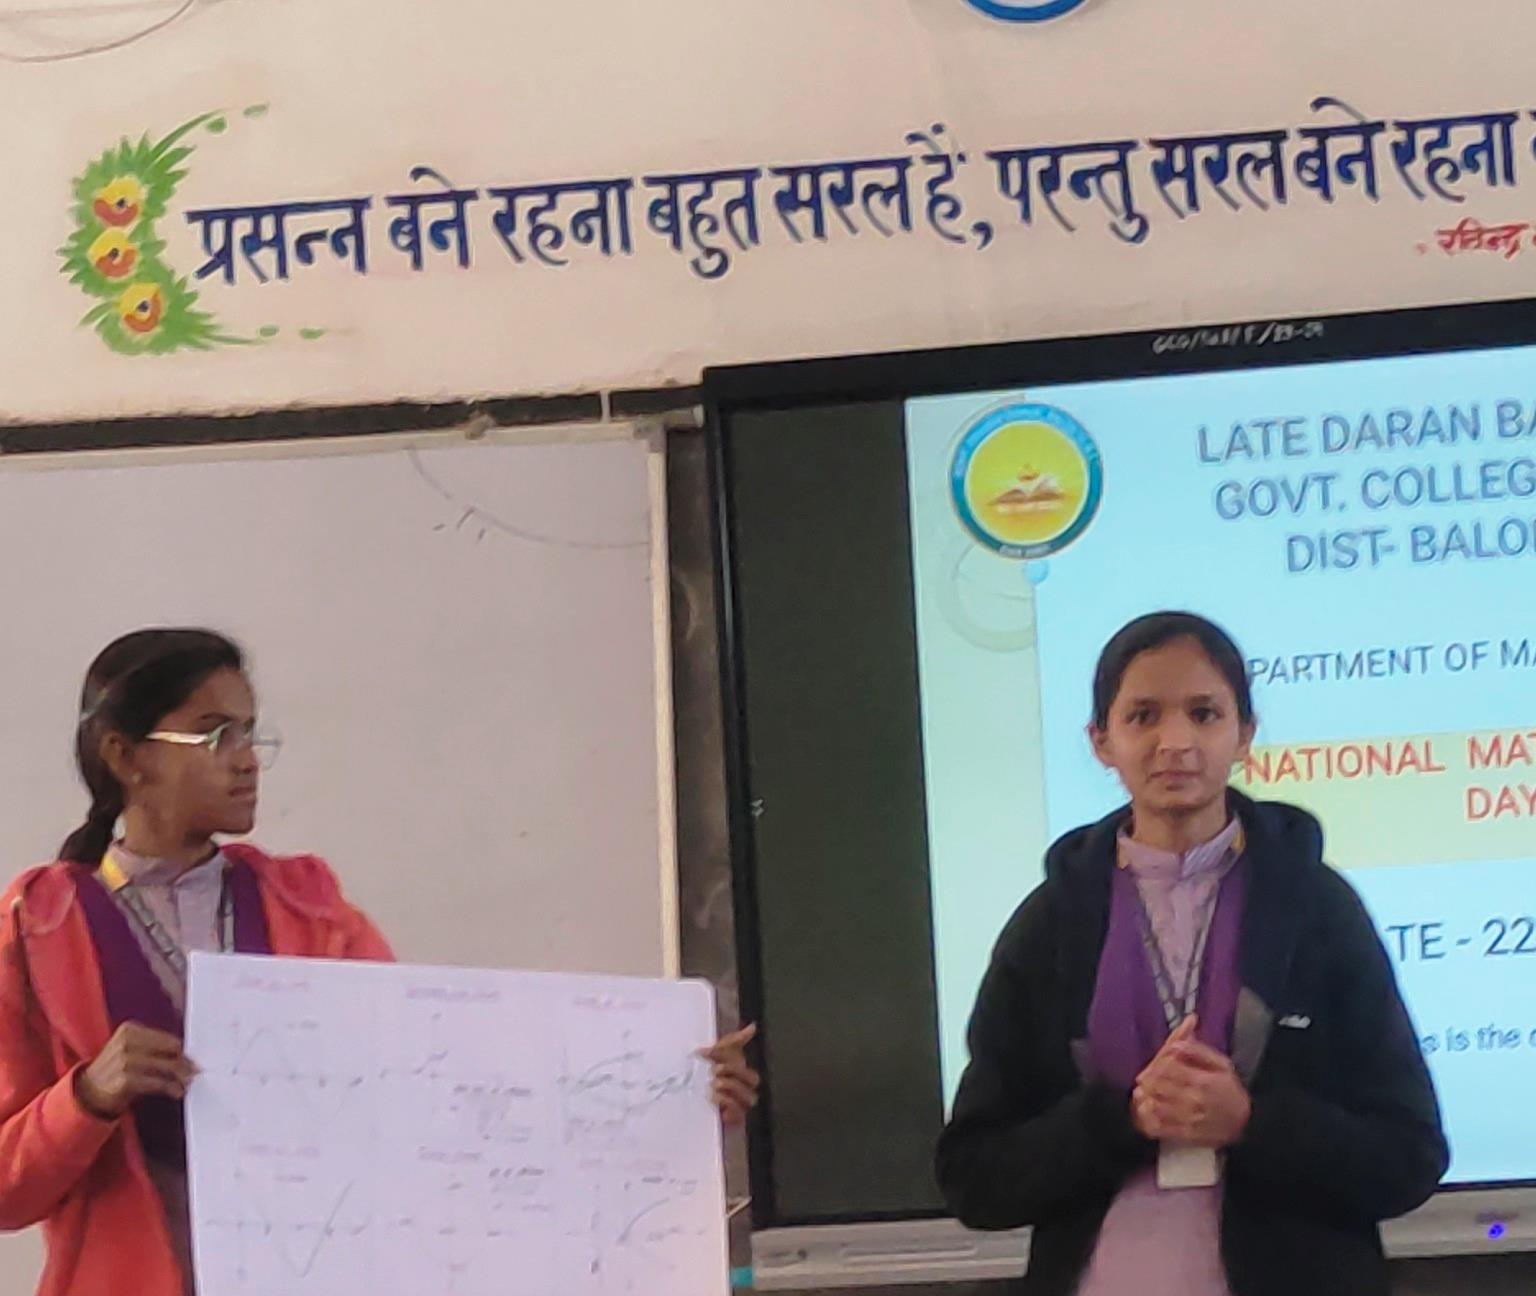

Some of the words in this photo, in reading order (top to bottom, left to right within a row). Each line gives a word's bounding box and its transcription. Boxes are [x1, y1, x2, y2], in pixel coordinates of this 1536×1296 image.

[186, 196, 373, 284] प्रसन्न
[386, 167, 478, 270] बने
[488, 177, 633, 264] रहना
[642, 167, 762, 278] बहुत
[769, 155, 912, 243] सरल
[985, 139, 1139, 245] परन्तु
[1149, 129, 1289, 220] सरल
[1295, 97, 1386, 204] बने
[1392, 111, 1519, 201] रहना
[1197, 416, 1308, 464] LATE
[1322, 403, 1481, 455] DARAN
[1215, 472, 1347, 521] GOVT.
[1287, 528, 1395, 573] DIST-
[1249, 644, 1434, 686] PARTMENT
[1444, 639, 1489, 673] OF
[1243, 739, 1446, 786] NATIONAL
[1387, 922, 1446, 962] TE
[1446, 1025, 1470, 1053] is
[1477, 1021, 1522, 1051] the
